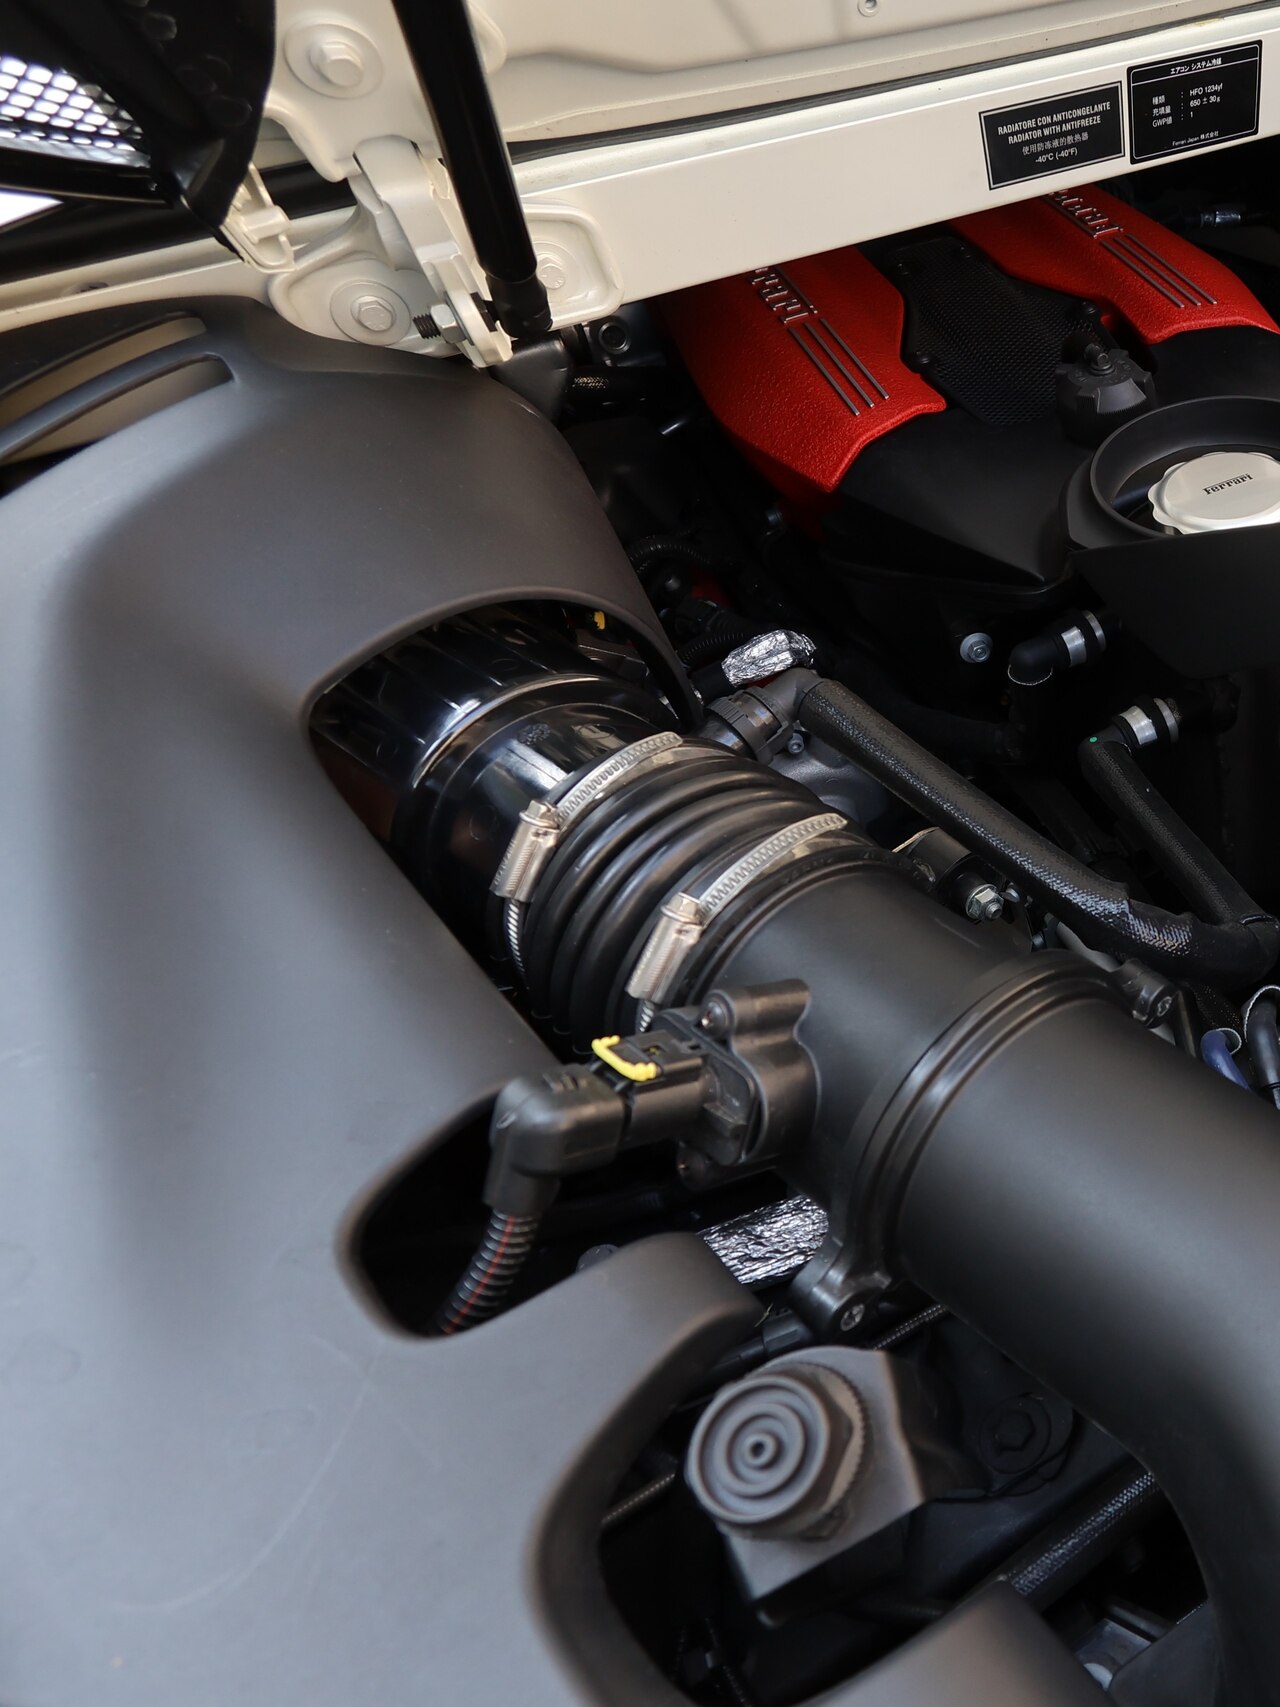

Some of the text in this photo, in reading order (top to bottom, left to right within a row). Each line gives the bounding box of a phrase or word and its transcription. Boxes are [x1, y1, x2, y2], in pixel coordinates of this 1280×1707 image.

[1189, 87, 1204, 97] HFO
[1204, 83, 1223, 93] 1234yf
[1189, 98, 1201, 108] 650
[998, 101, 1111, 135] RADIATORE CON ANTICONGELANTE
[1008, 115, 1102, 145] RADIATOR WITH ANTIFREEZE
[1187, 135, 1200, 144] Japan
[1022, 132, 1089, 155] 使用防冻液的散热器
[1202, 473, 1254, 495] Ferrari
